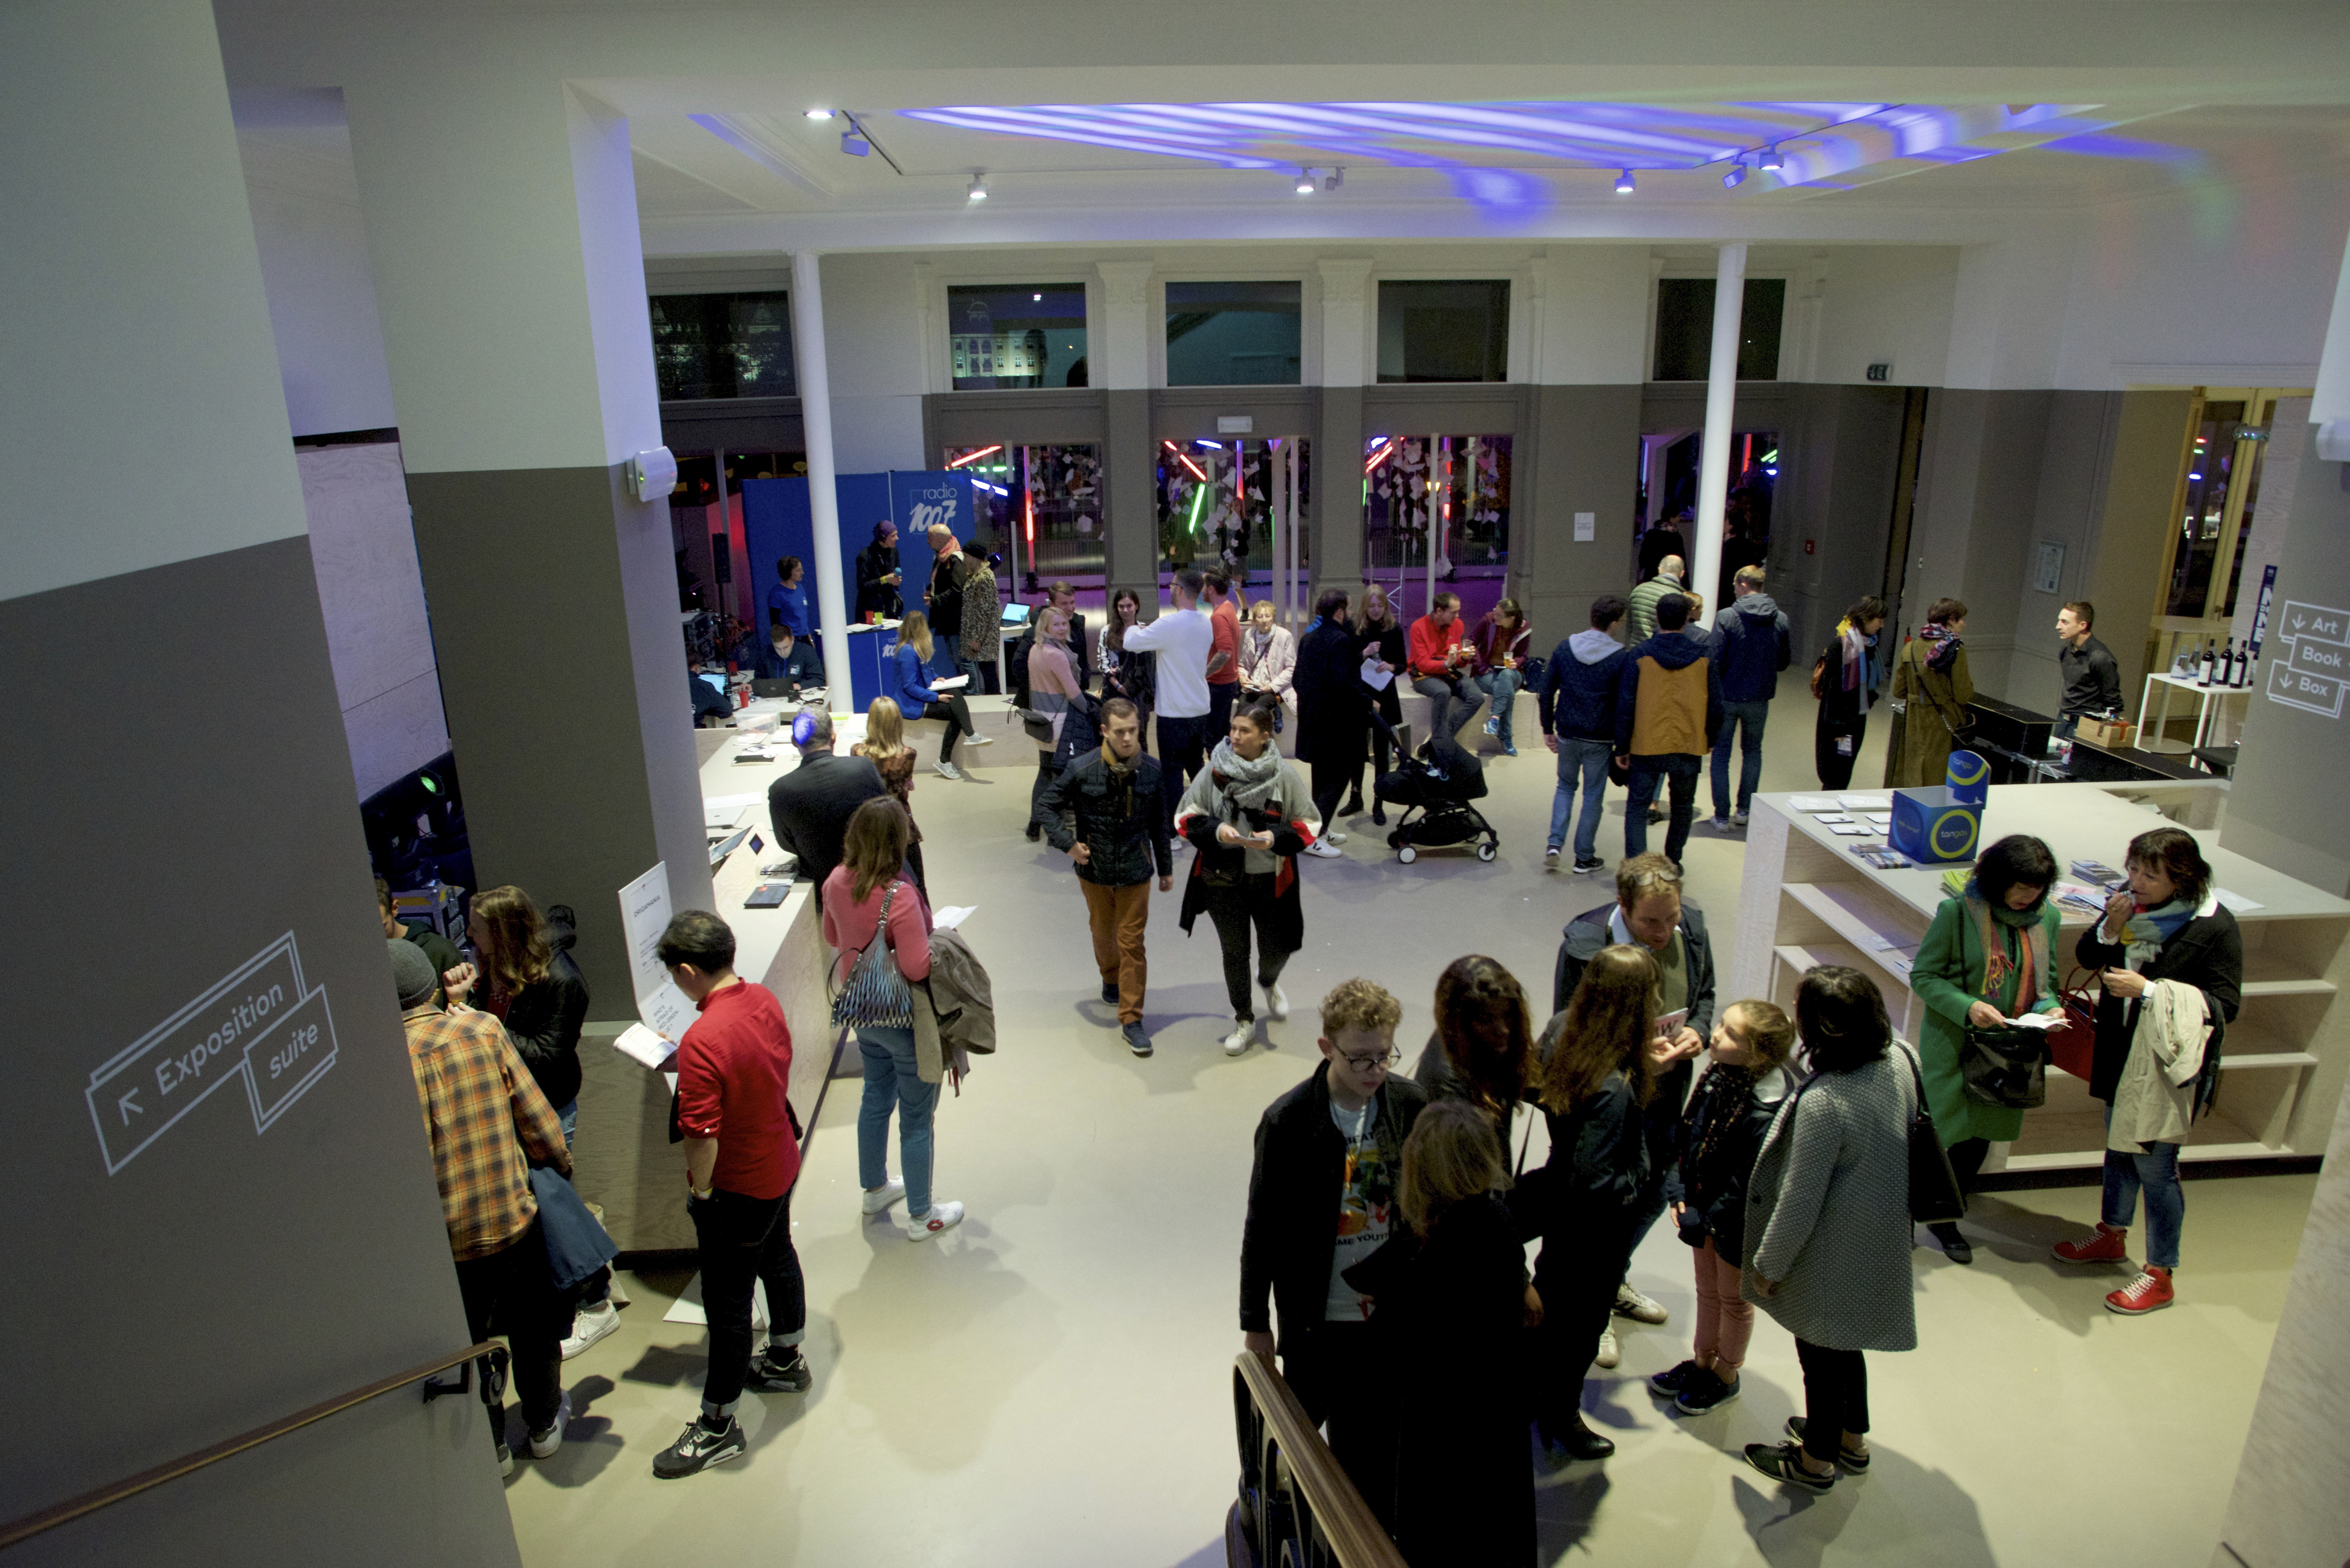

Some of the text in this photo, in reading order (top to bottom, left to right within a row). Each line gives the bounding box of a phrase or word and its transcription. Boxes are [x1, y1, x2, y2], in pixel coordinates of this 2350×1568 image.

[923, 481, 958, 499] radio
[2311, 617, 2339, 635] Art
[2302, 645, 2342, 668] Book
[2299, 676, 2329, 697] Box
[154, 983, 284, 1096] Exposition
[269, 1023, 318, 1080] suite
